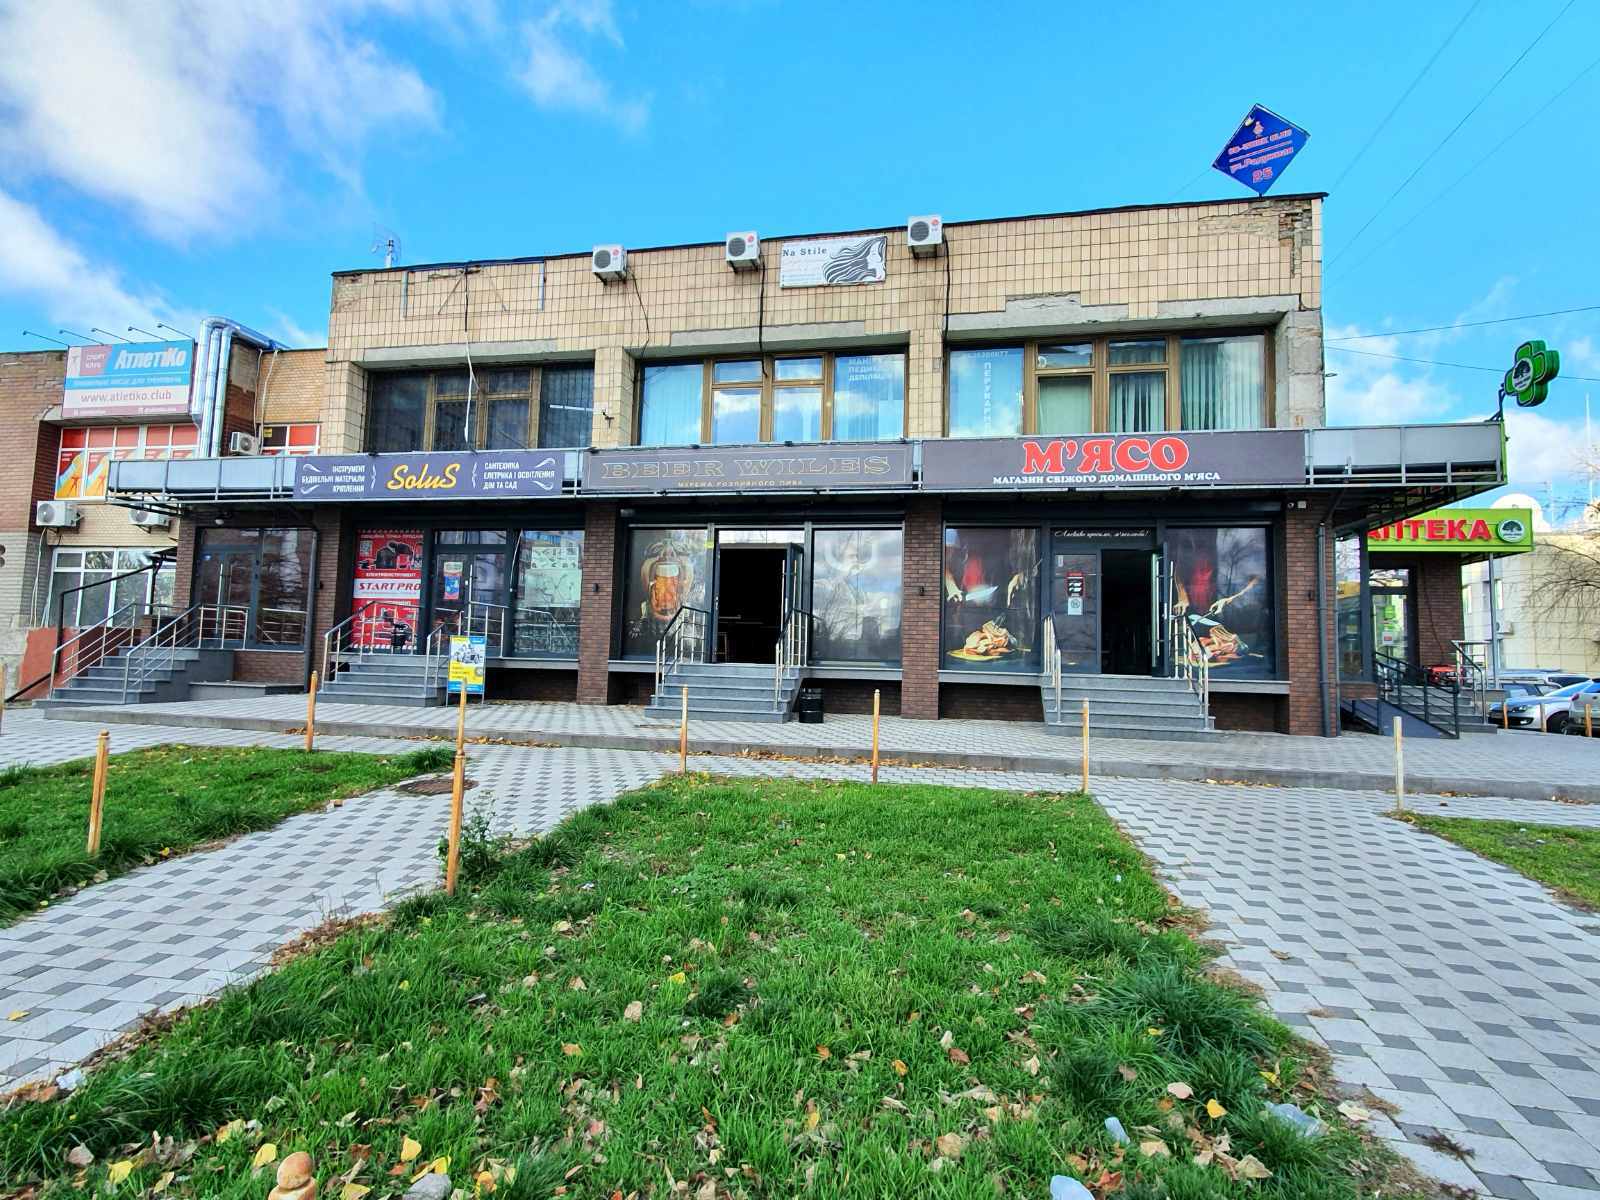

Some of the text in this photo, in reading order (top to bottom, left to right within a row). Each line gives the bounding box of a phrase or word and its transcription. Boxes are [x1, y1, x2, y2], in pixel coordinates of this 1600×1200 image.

[782, 247, 828, 257] Na Stile
[80, 389, 172, 403] www.atletiko.club
[1022, 437, 1190, 475] М'ЯСО
[601, 456, 891, 479] BEER WILES
[517, 470, 555, 479] ОСВІТЛЕННЯ
[992, 472, 1222, 485] МАГАЗИН СВІЖОГО ДОМАШНЬОГО М'ЯСА
[302, 476, 334, 484] БУДІВЕЛЬНІ
[483, 481, 496, 490] ДІМ
[504, 481, 518, 490] САД
[359, 582, 423, 591] START PRO
